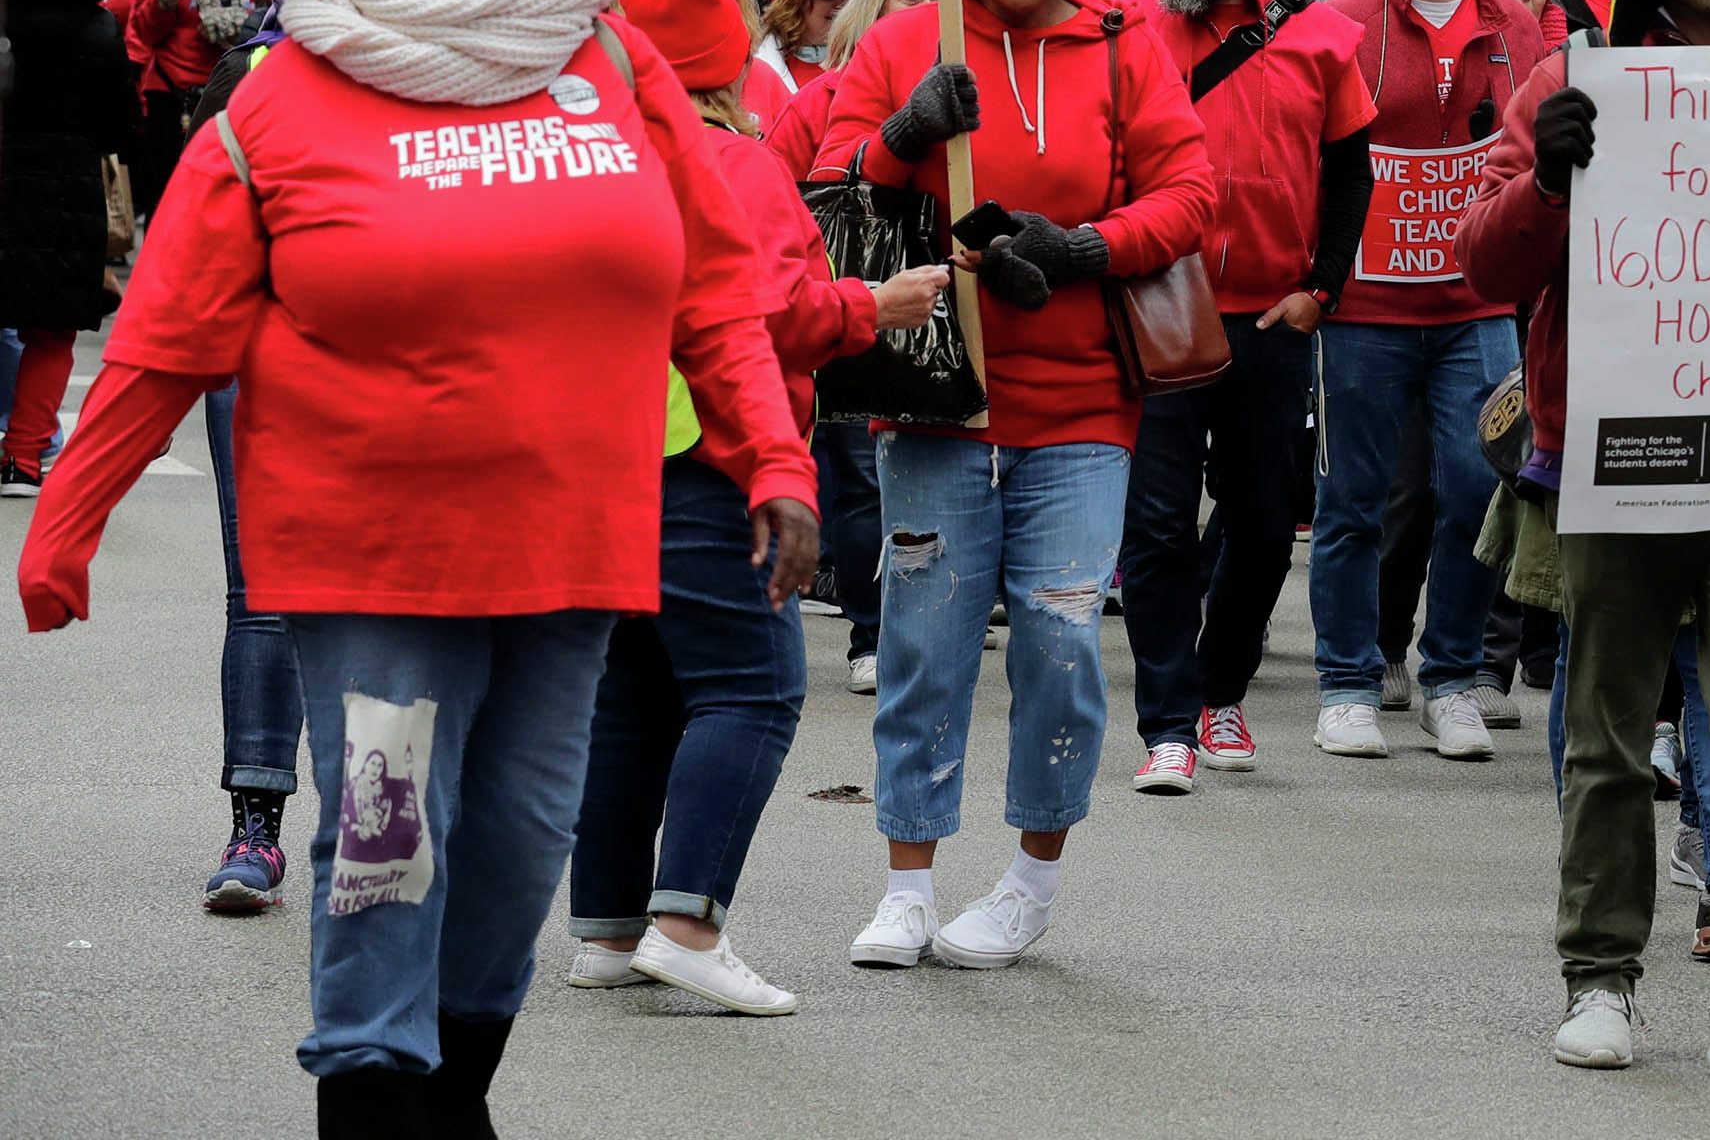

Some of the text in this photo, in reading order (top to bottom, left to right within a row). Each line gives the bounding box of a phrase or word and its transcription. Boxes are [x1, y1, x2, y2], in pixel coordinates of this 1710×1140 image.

[389, 116, 568, 165] TEACHERS
[399, 156, 480, 180] PREPARE
[480, 141, 638, 186] FUTURE
[1371, 157, 1410, 184] WE
[426, 172, 462, 191] THE
[1388, 249, 1445, 272] AND
[1606, 435, 1682, 447] Fighting for the
[1605, 446, 1695, 458] schools Chicago's
[1604, 458, 1688, 468] students deserve
[1615, 499, 1659, 508] American
[1661, 497, 1710, 507] Federation
